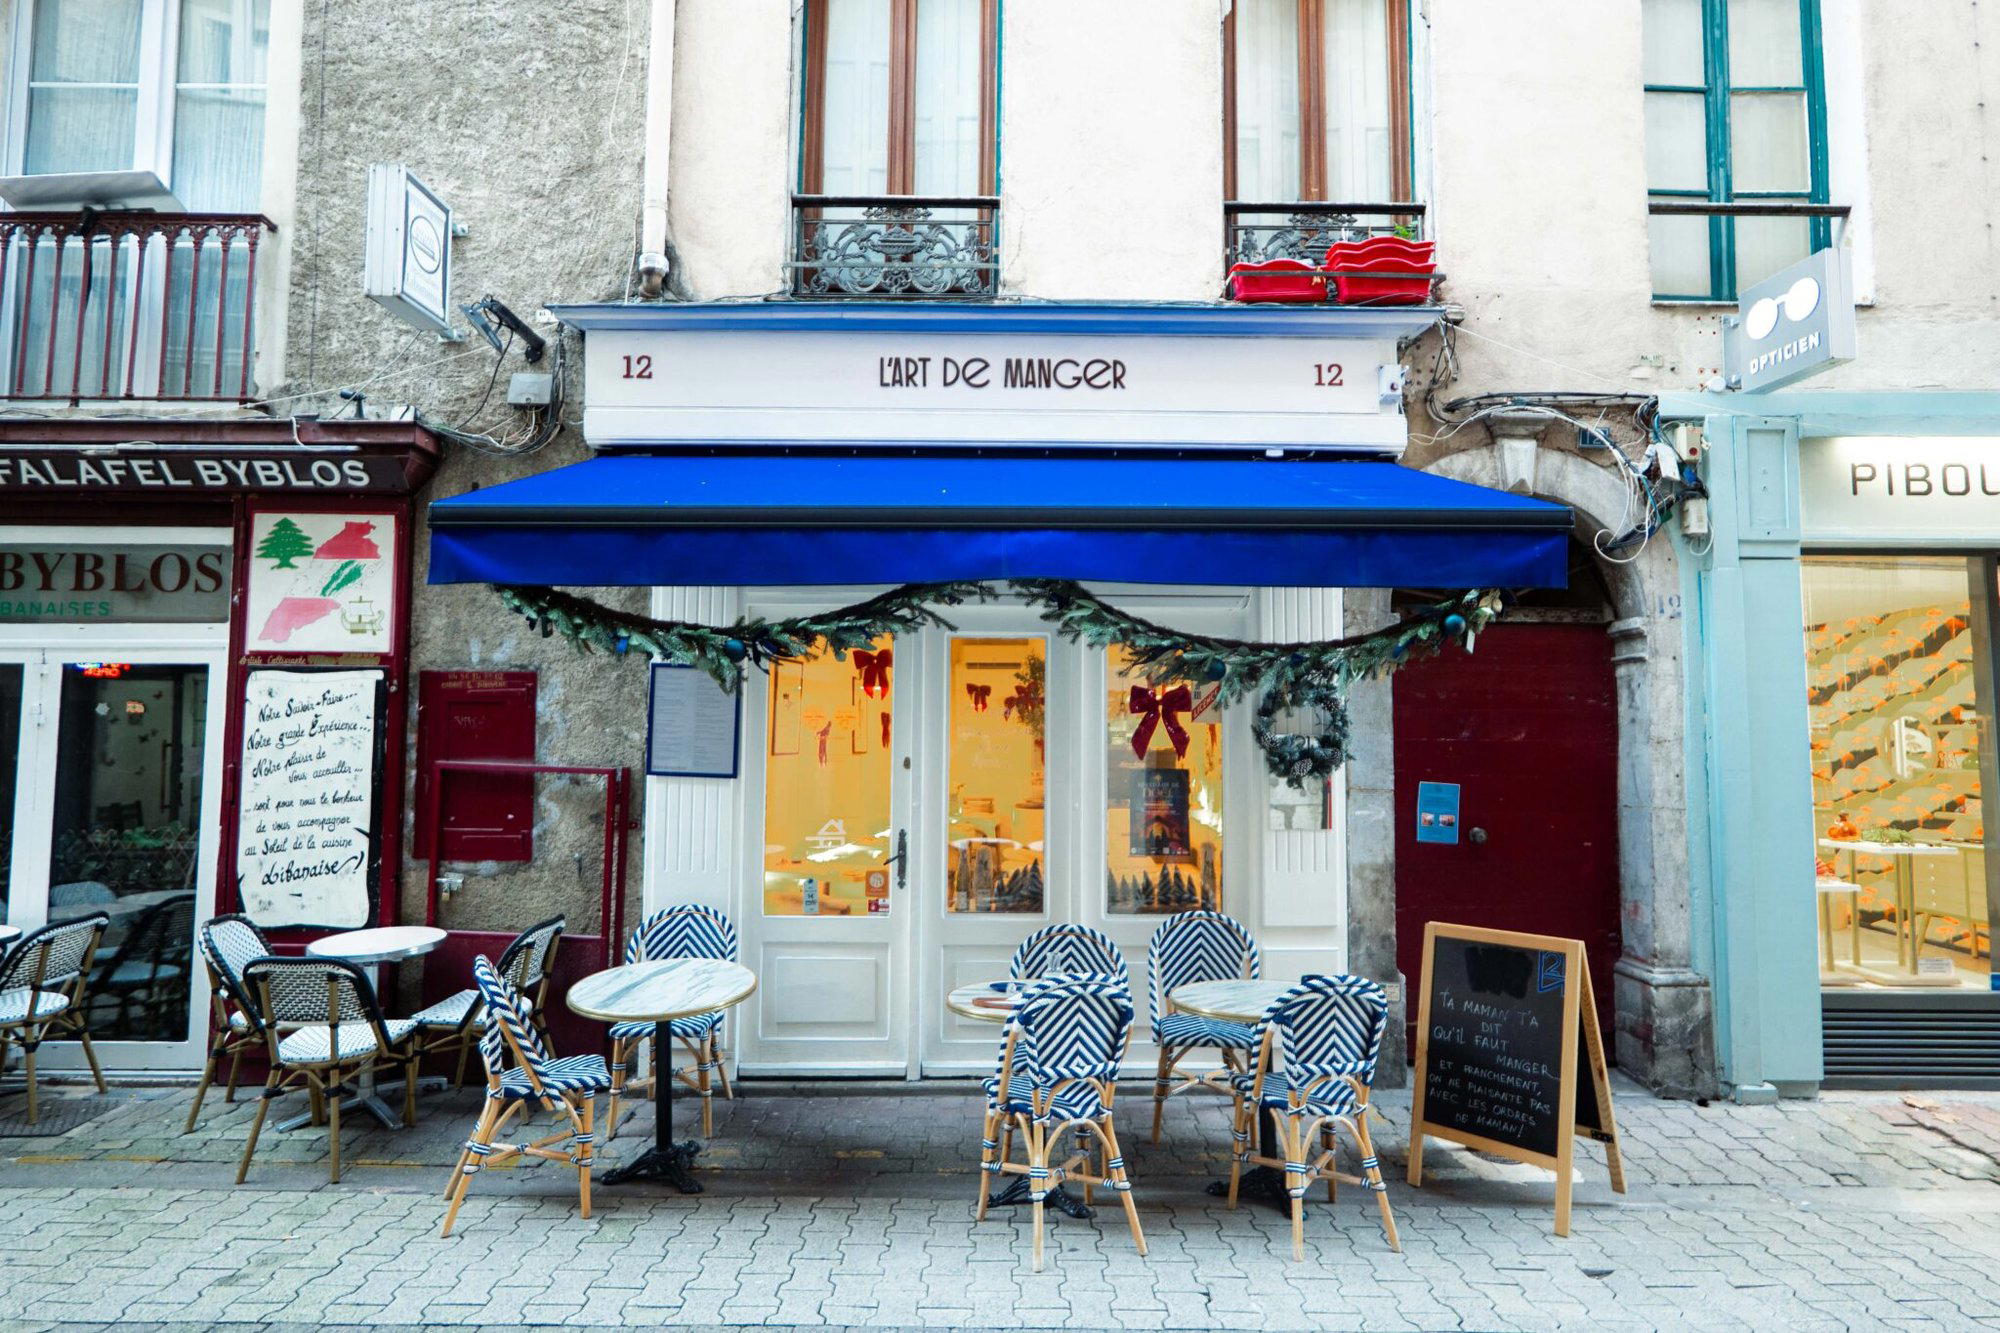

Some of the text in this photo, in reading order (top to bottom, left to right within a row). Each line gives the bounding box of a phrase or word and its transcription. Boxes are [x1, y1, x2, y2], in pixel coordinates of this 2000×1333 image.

[622, 354, 653, 379] 12
[1750, 330, 1821, 375] OPTICIEN
[879, 356, 931, 388] L'ART
[1314, 363, 1344, 387] 12
[194, 459, 371, 488] BYBLOS
[0, 551, 224, 594] BYBLOS
[1439, 990, 1455, 1010] TA
[1463, 1000, 1509, 1021] MAMAN
[1481, 1021, 1502, 1034] DIT
[1474, 1034, 1508, 1051] FAUT
[1440, 1059, 1454, 1070] ET
[1496, 1054, 1553, 1078] MANGER
[1429, 1073, 1552, 1115] ON NE PLAISANTE PAS
[1429, 1086, 1536, 1127] AVEC LES ORDRES
